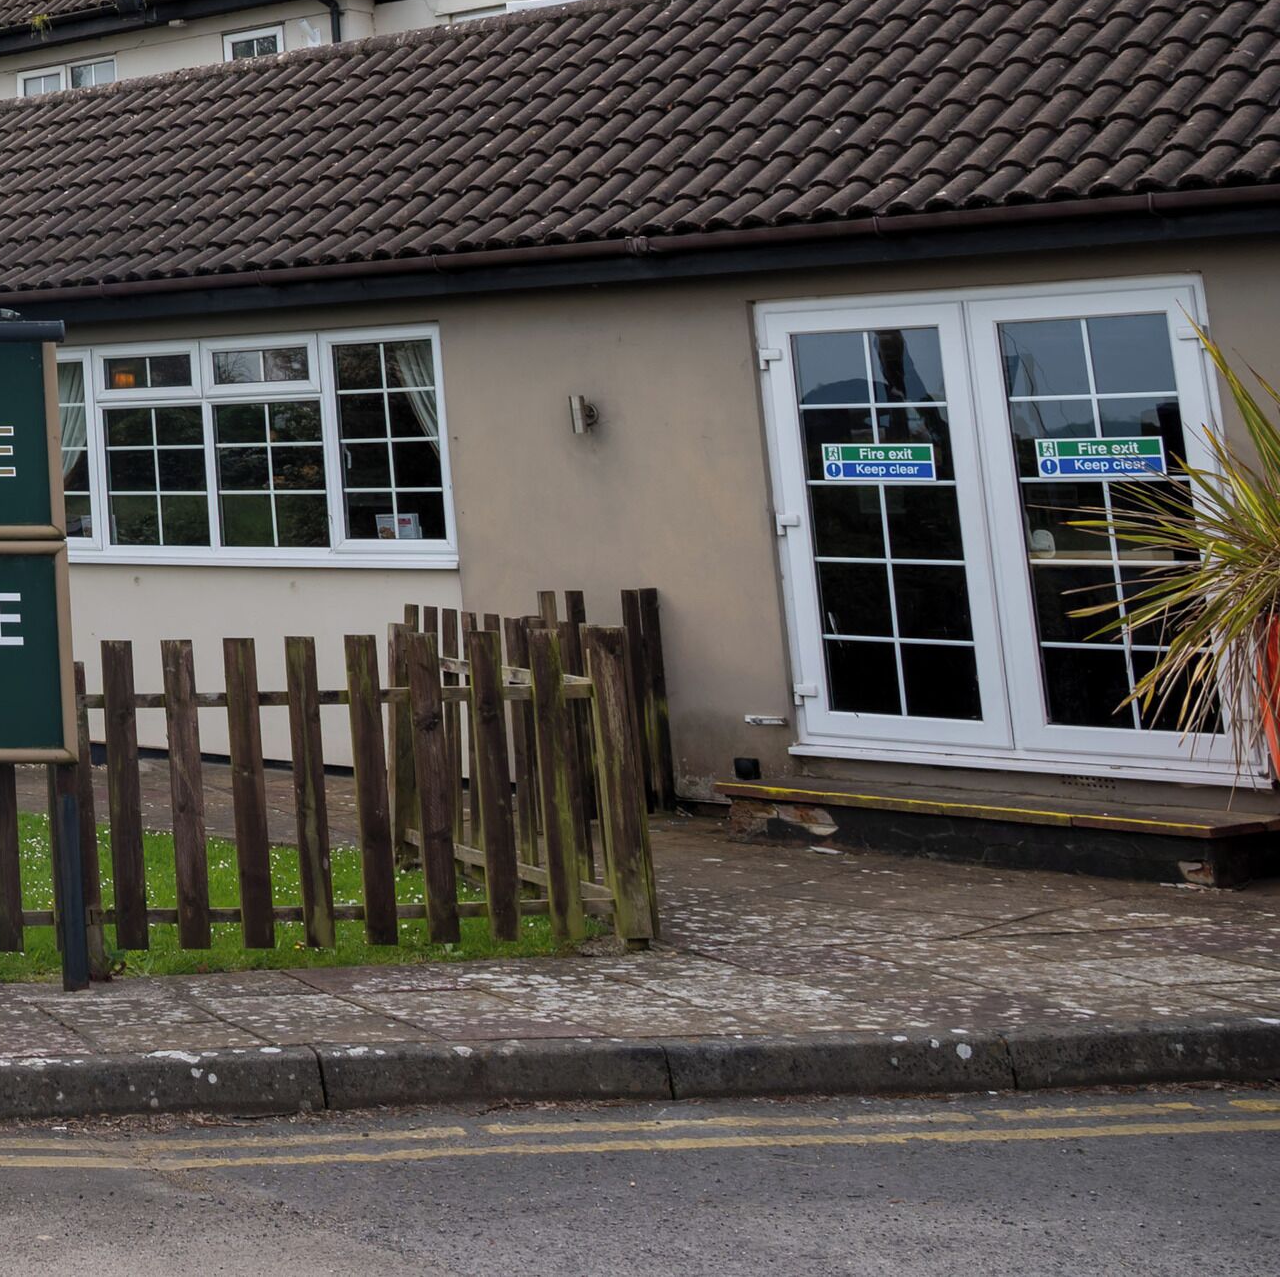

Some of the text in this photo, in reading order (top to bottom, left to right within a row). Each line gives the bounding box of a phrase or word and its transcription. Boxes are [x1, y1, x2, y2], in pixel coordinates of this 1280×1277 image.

[859, 448, 912, 459] Fire exit
[1077, 441, 1139, 454] Fire exit
[856, 464, 919, 476] Keep clear
[1074, 460, 1109, 472] Keep
